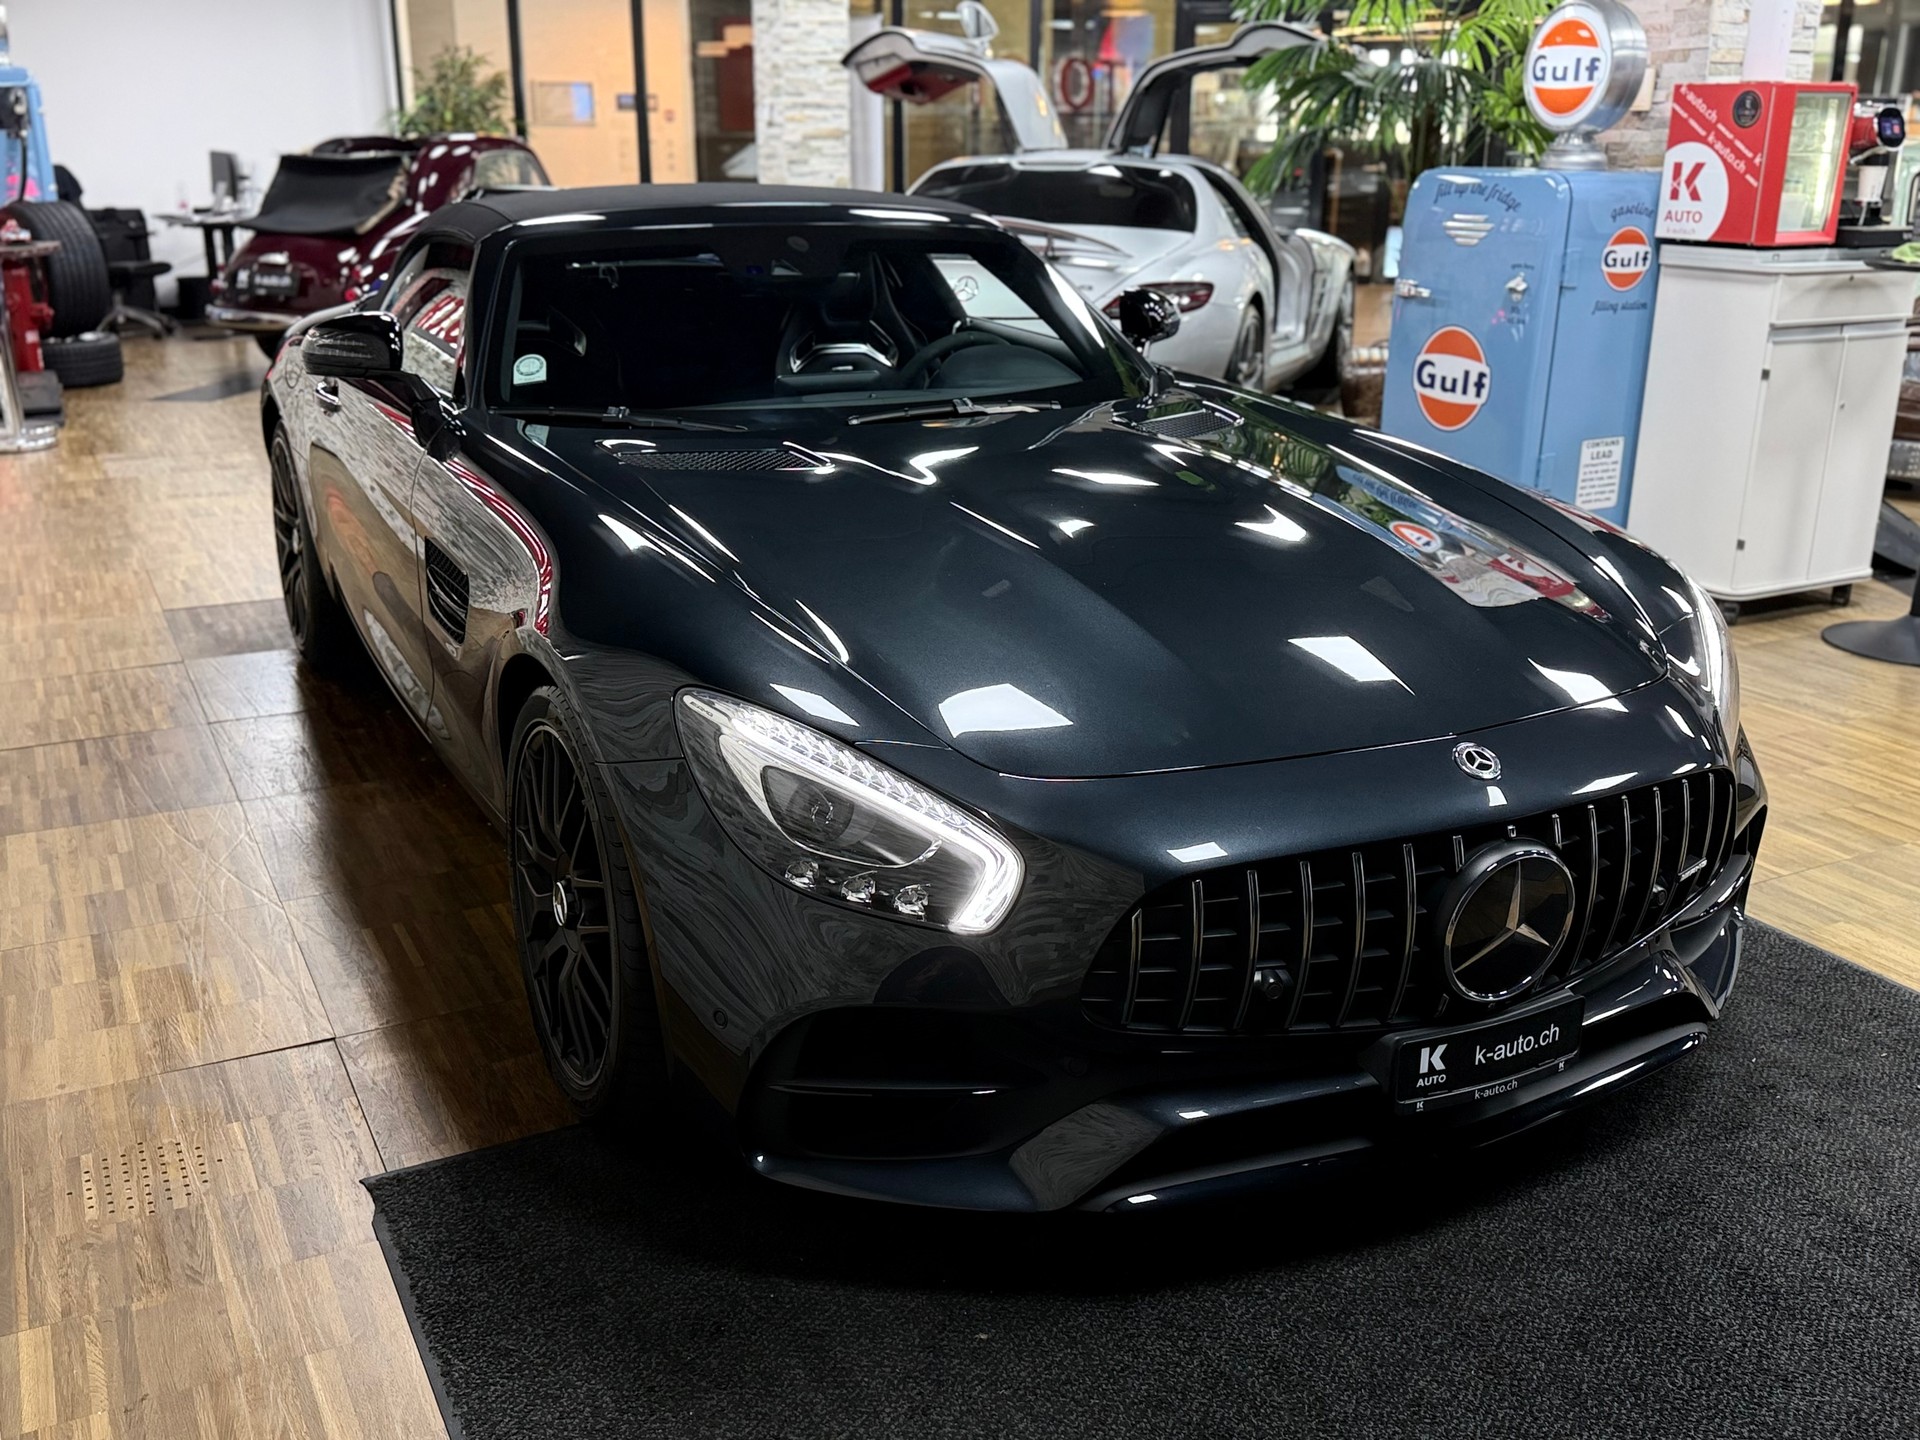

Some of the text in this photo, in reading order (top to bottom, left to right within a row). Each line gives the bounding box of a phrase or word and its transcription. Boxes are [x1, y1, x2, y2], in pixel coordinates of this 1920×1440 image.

[1532, 54, 1601, 82] Gulf
[1679, 85, 1718, 123] k-auto.ch
[1707, 132, 1747, 173] k-auto.ch
[1670, 162, 1706, 201] K
[1471, 183, 1486, 195] the
[1485, 183, 1522, 212] fridge
[1610, 202, 1655, 222] gasoline
[1664, 210, 1702, 223] AUTO
[1604, 250, 1650, 268] Gulf
[1416, 360, 1488, 398] Gulf
[1591, 451, 1613, 460] LEAD
[1419, 1043, 1448, 1074] K
[1475, 1023, 1560, 1066] k-auto.ch
[1416, 1074, 1447, 1088] AUTO
[1474, 1079, 1518, 1100] k-auto.ch
